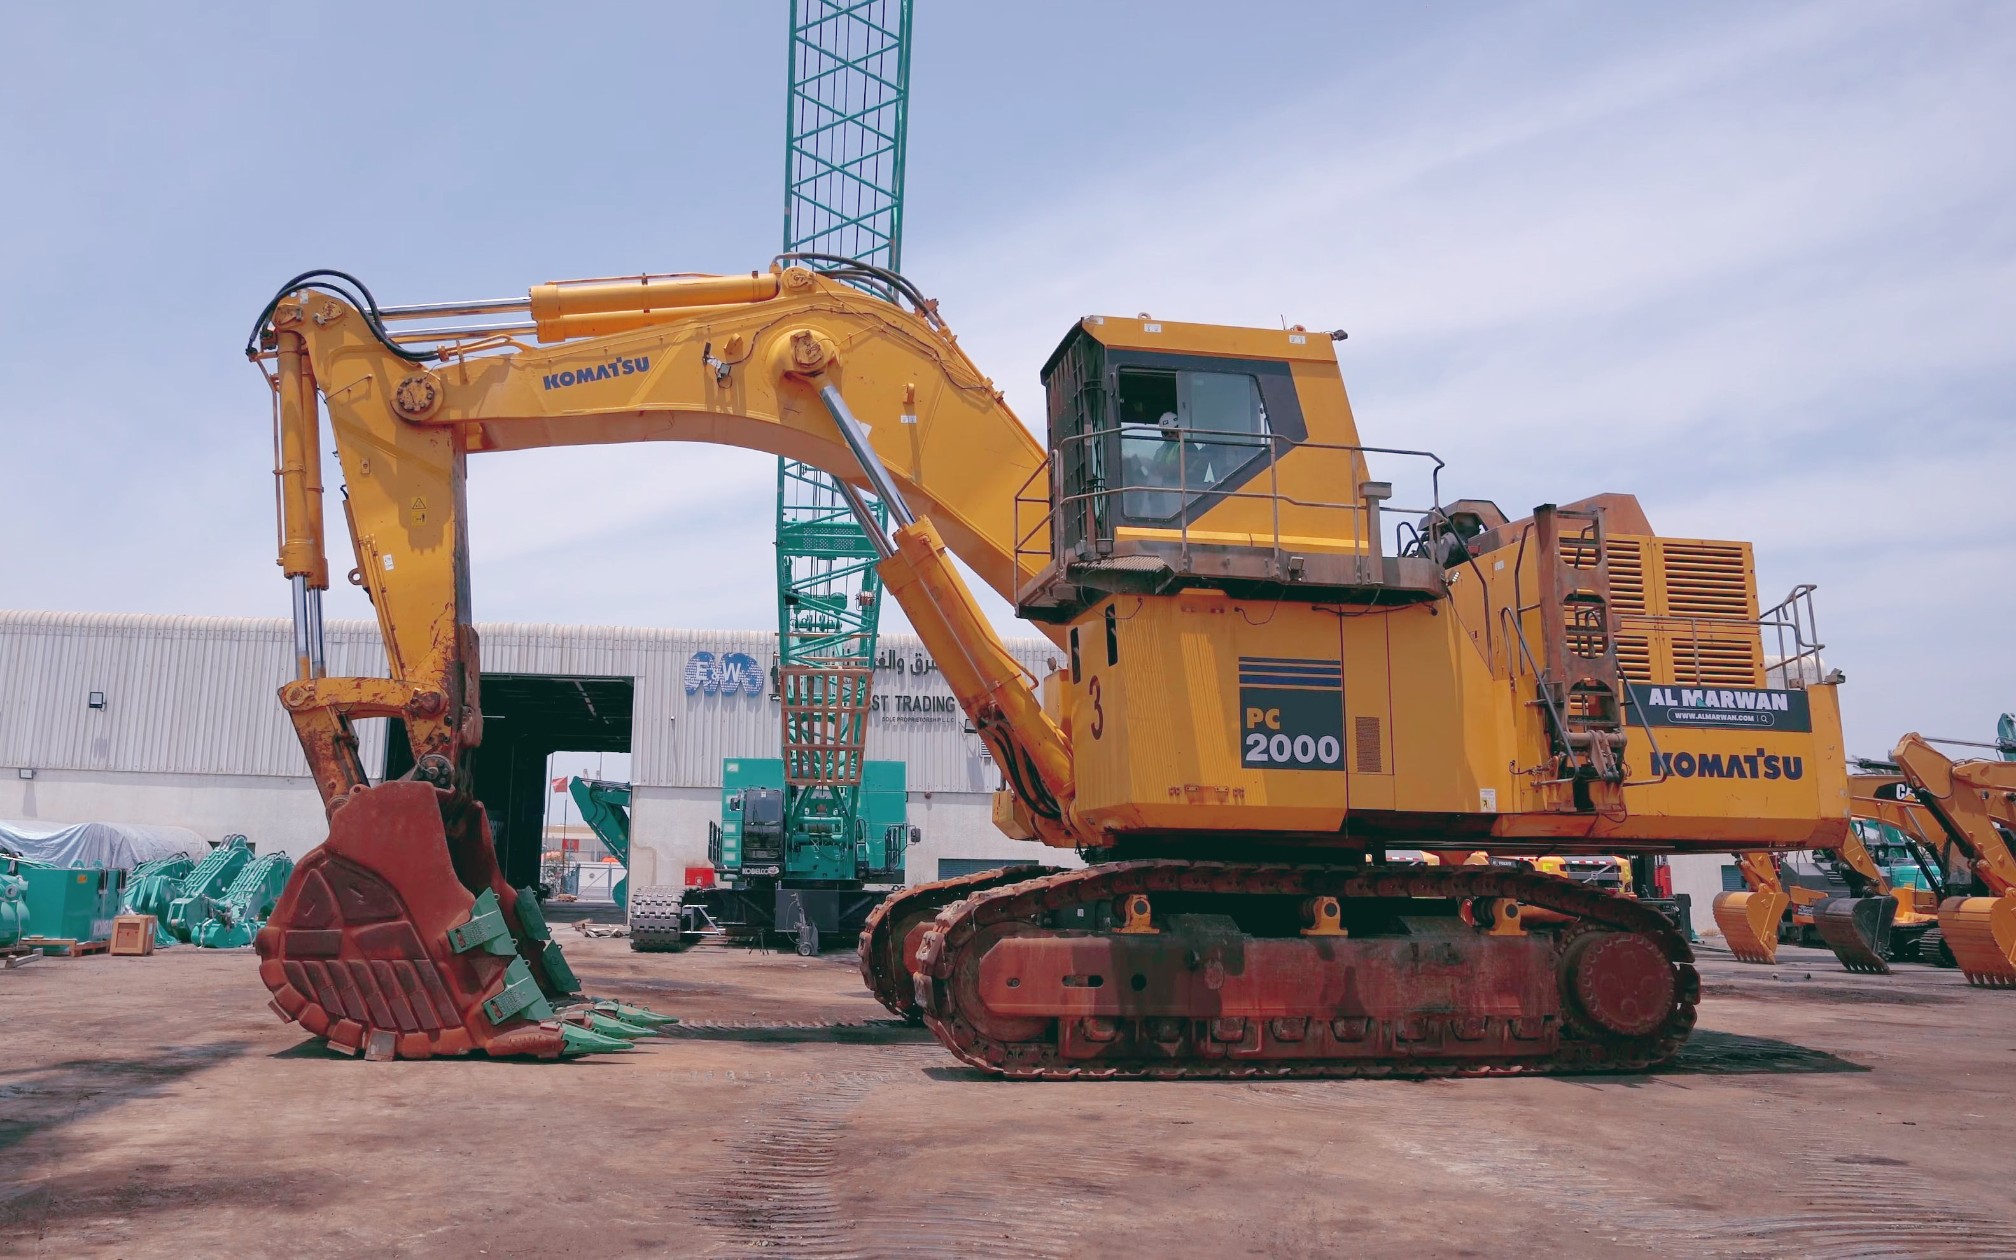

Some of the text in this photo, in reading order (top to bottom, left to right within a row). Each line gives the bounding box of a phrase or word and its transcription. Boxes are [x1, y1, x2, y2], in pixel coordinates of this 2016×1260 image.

[542, 356, 650, 391] KOMATSU
[895, 695, 955, 712] TRADING
[1089, 675, 1104, 740] 3
[1649, 688, 1788, 711] AL MARWAN
[1246, 708, 1280, 730] PC
[1675, 712, 1754, 722] WWW.ALMARWAN.COM
[1245, 733, 1340, 764] 2000
[1650, 748, 1803, 780] KOMATSU
[742, 867, 769, 875] KOBELCO
